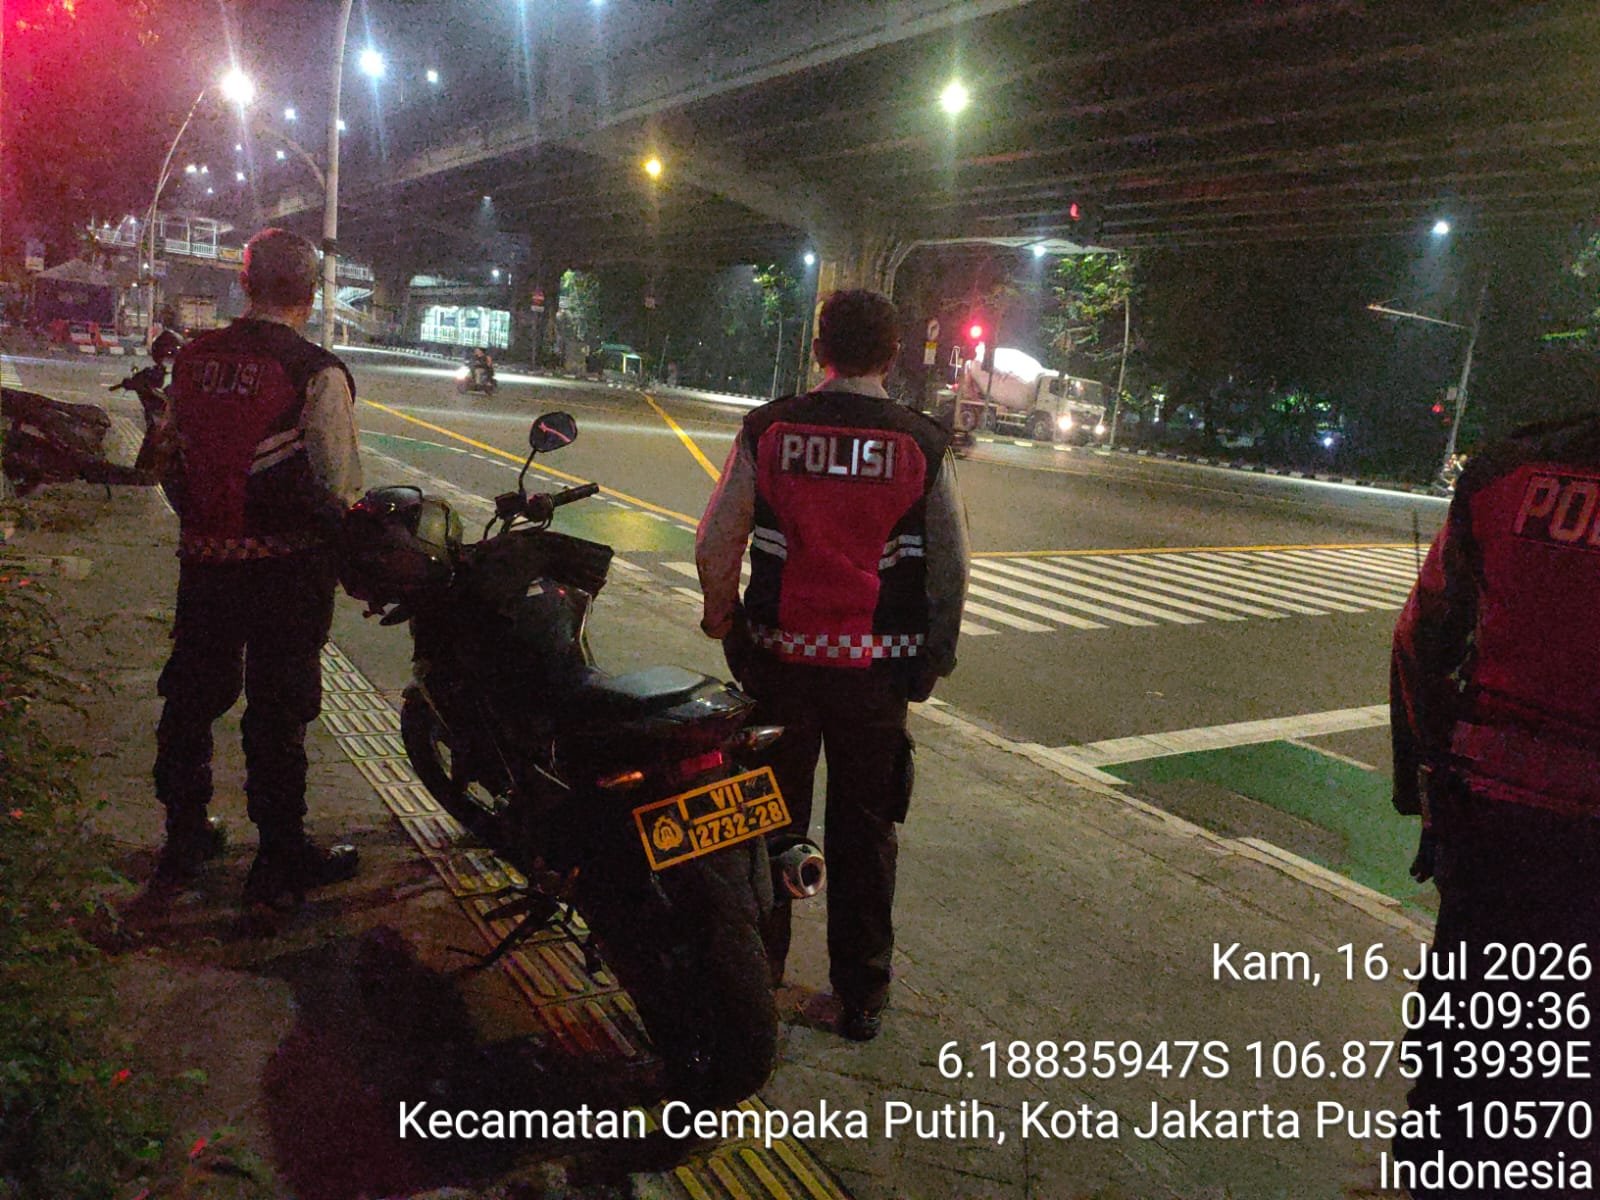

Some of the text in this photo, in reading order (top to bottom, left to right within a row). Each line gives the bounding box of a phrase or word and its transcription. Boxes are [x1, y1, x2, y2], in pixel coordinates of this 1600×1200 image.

[781, 434, 896, 479] POLISI
[710, 783, 743, 810] VII
[697, 801, 783, 848] 2732-28
